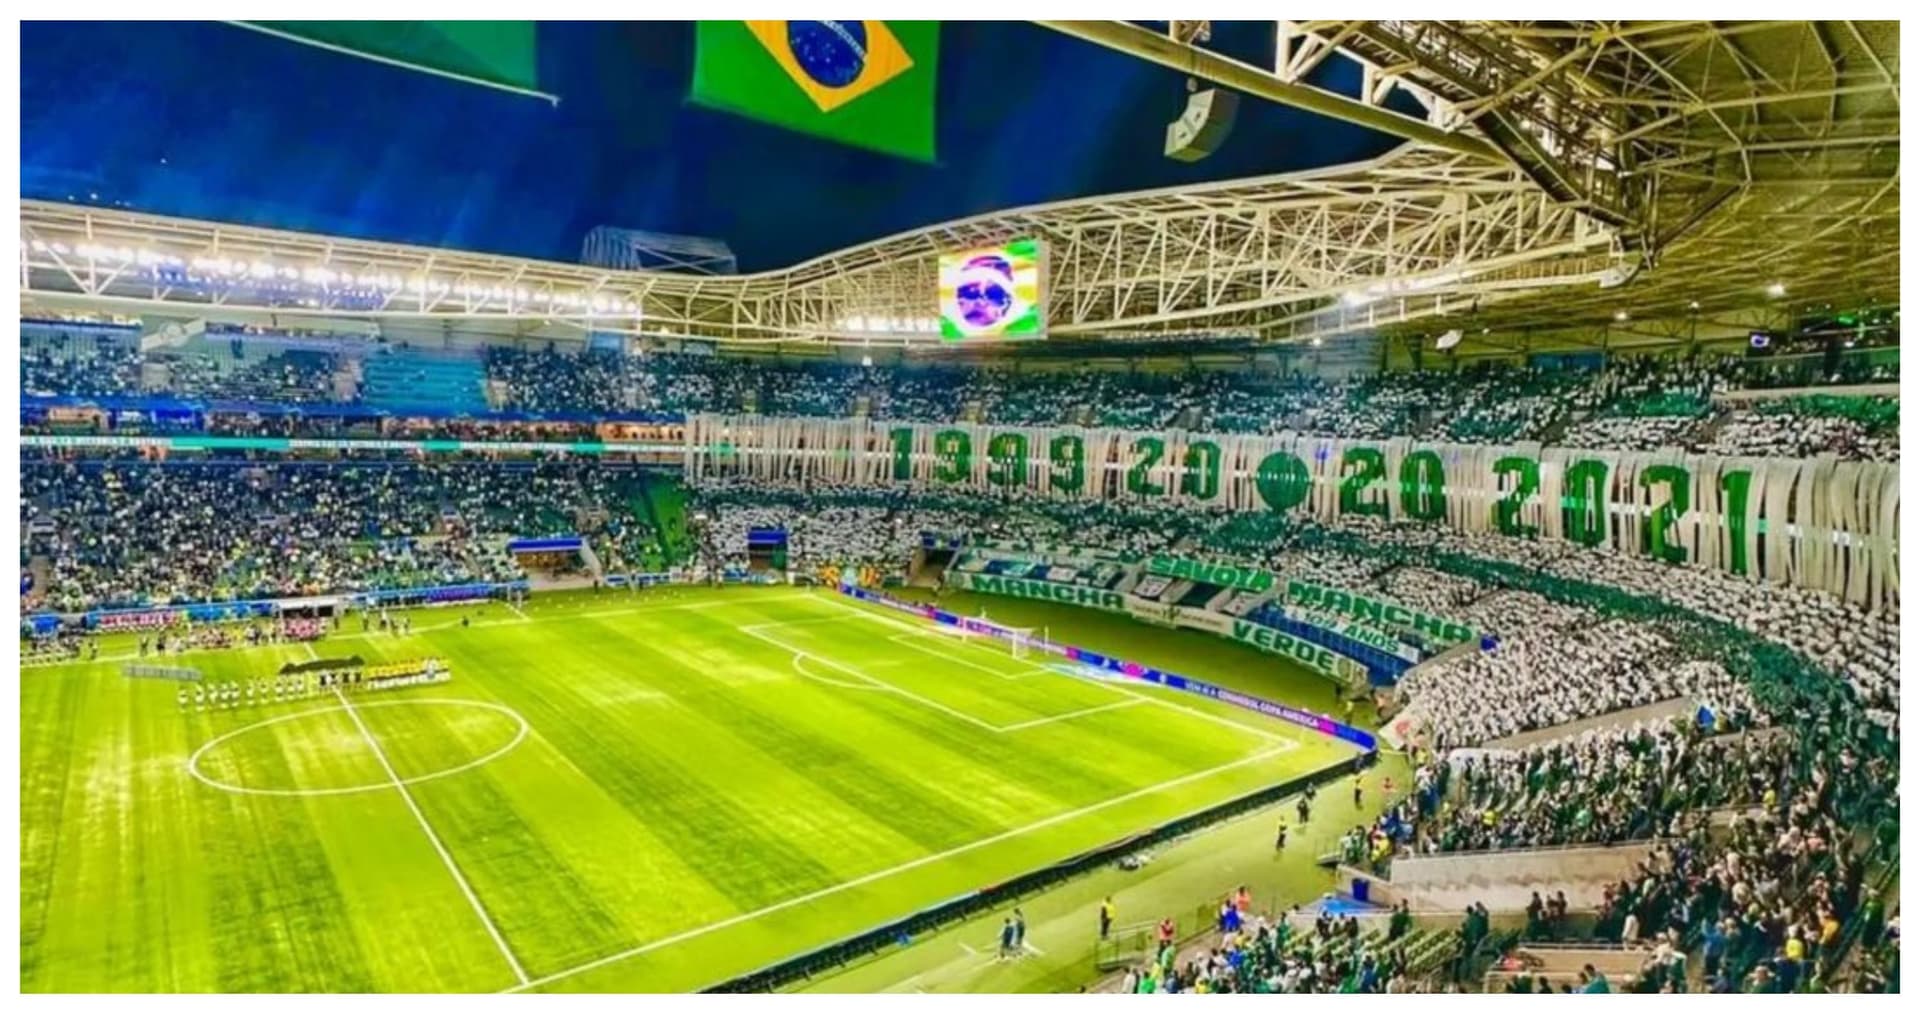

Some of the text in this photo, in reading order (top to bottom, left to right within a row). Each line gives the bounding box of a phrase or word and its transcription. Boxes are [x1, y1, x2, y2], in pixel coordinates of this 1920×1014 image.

[889, 428, 1752, 576] 1999 20 20 2021
[970, 574, 1124, 609] MANCHA
[1288, 581, 1473, 643] MANCHA
[1233, 620, 1334, 671] VERDE
